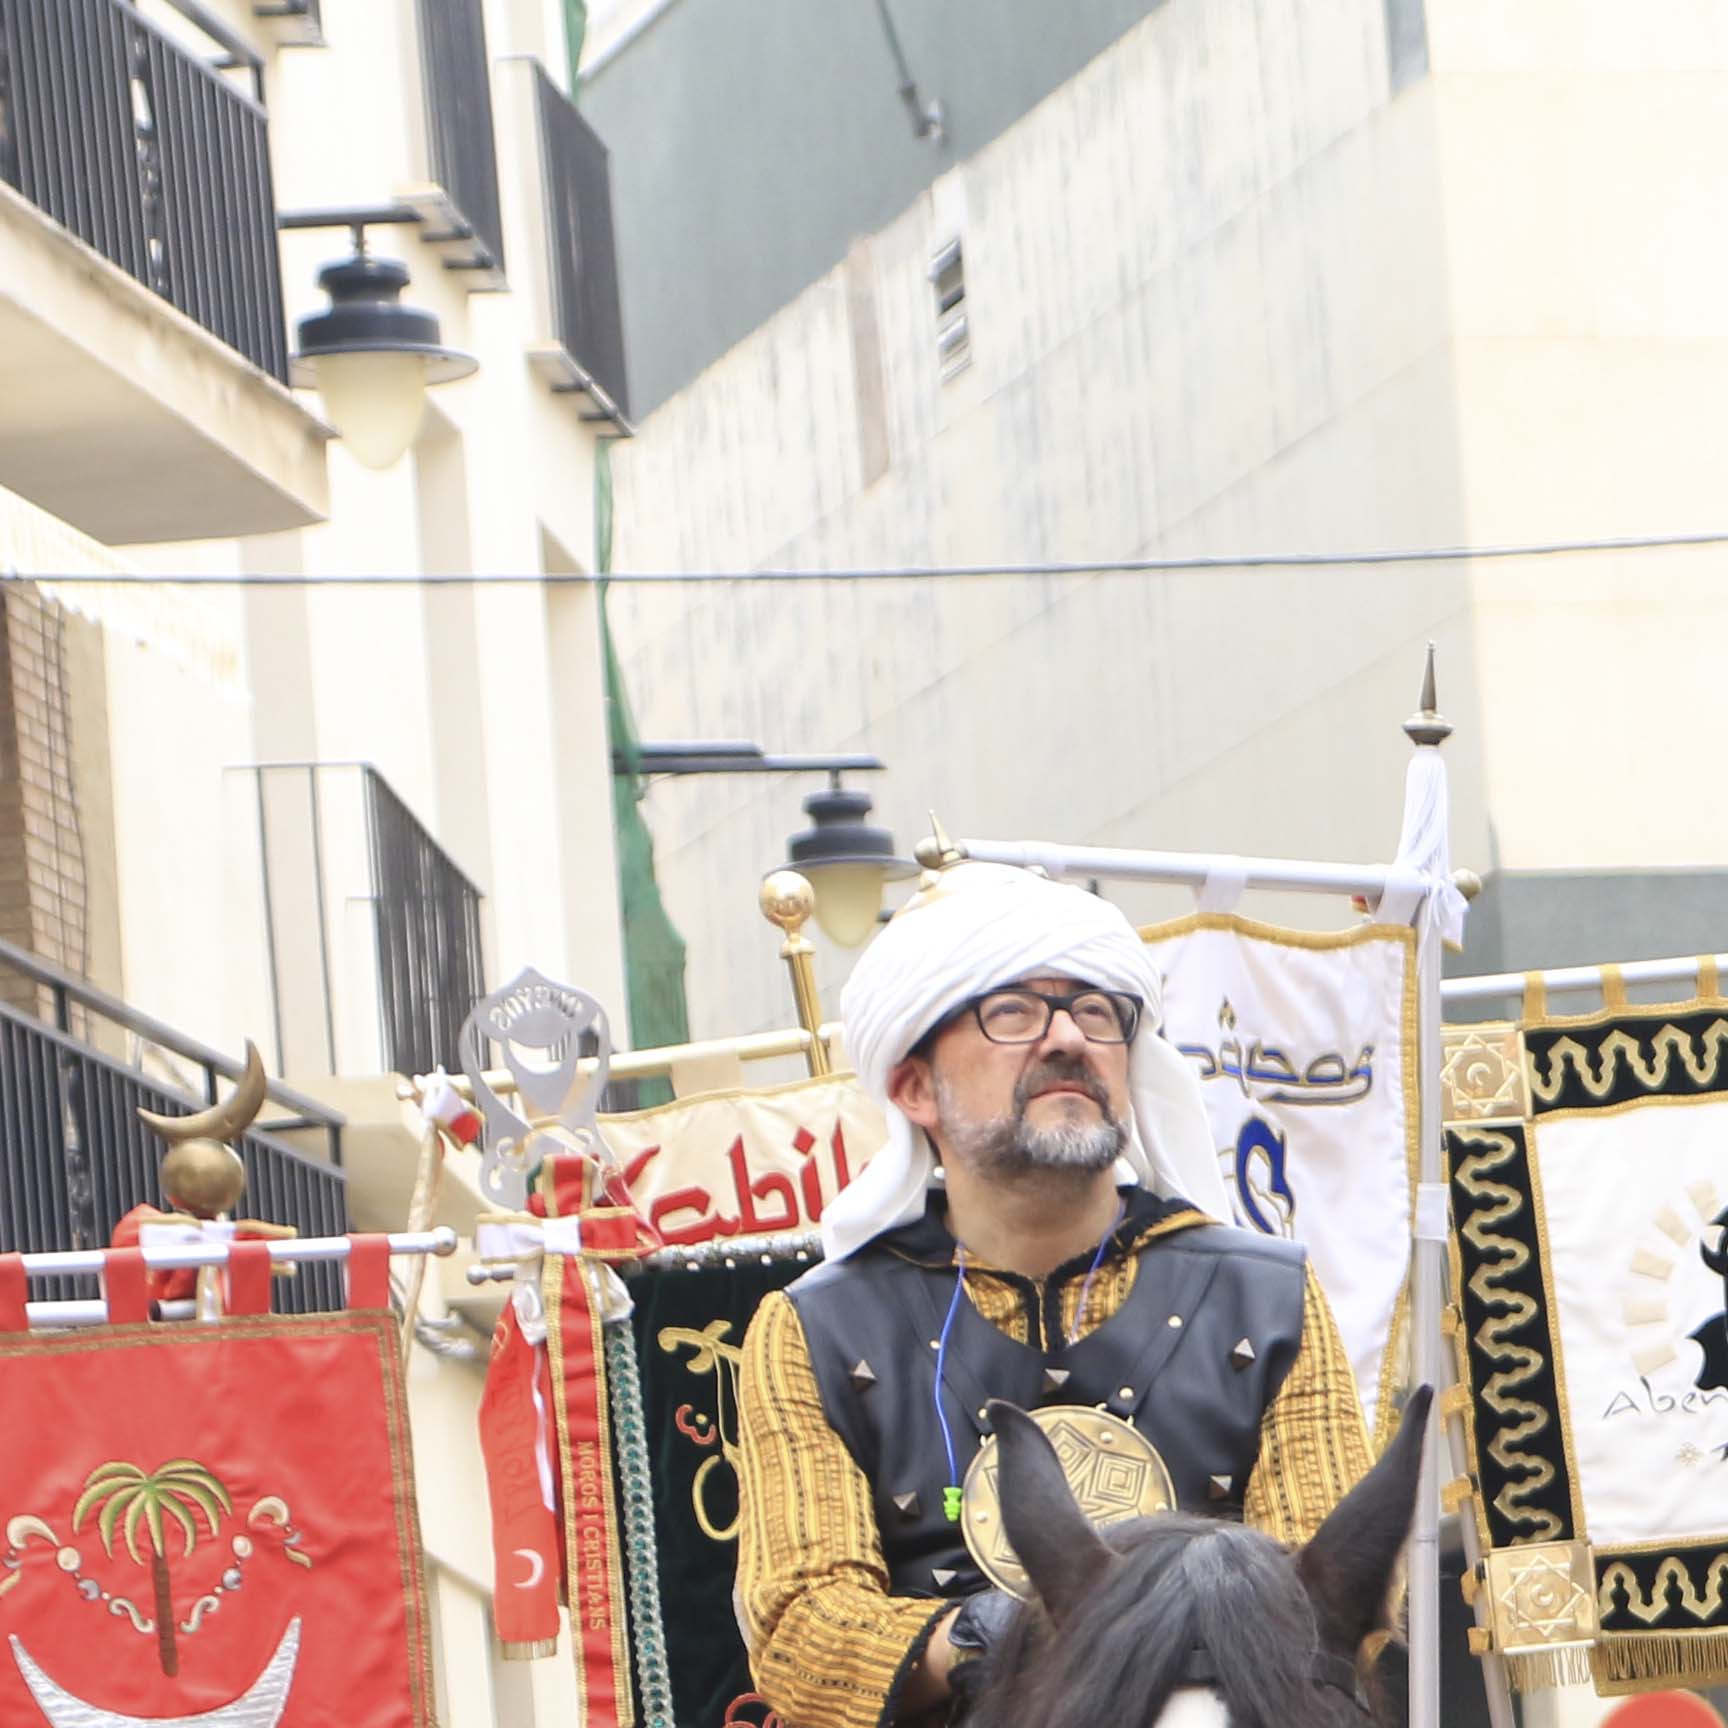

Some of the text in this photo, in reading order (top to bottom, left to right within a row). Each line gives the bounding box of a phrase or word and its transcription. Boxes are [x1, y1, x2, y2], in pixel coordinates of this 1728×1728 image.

[603, 1115, 869, 1246] Kabil
[576, 1440, 598, 1509] MOROS
[582, 1525, 608, 1631] CRISTIANS
